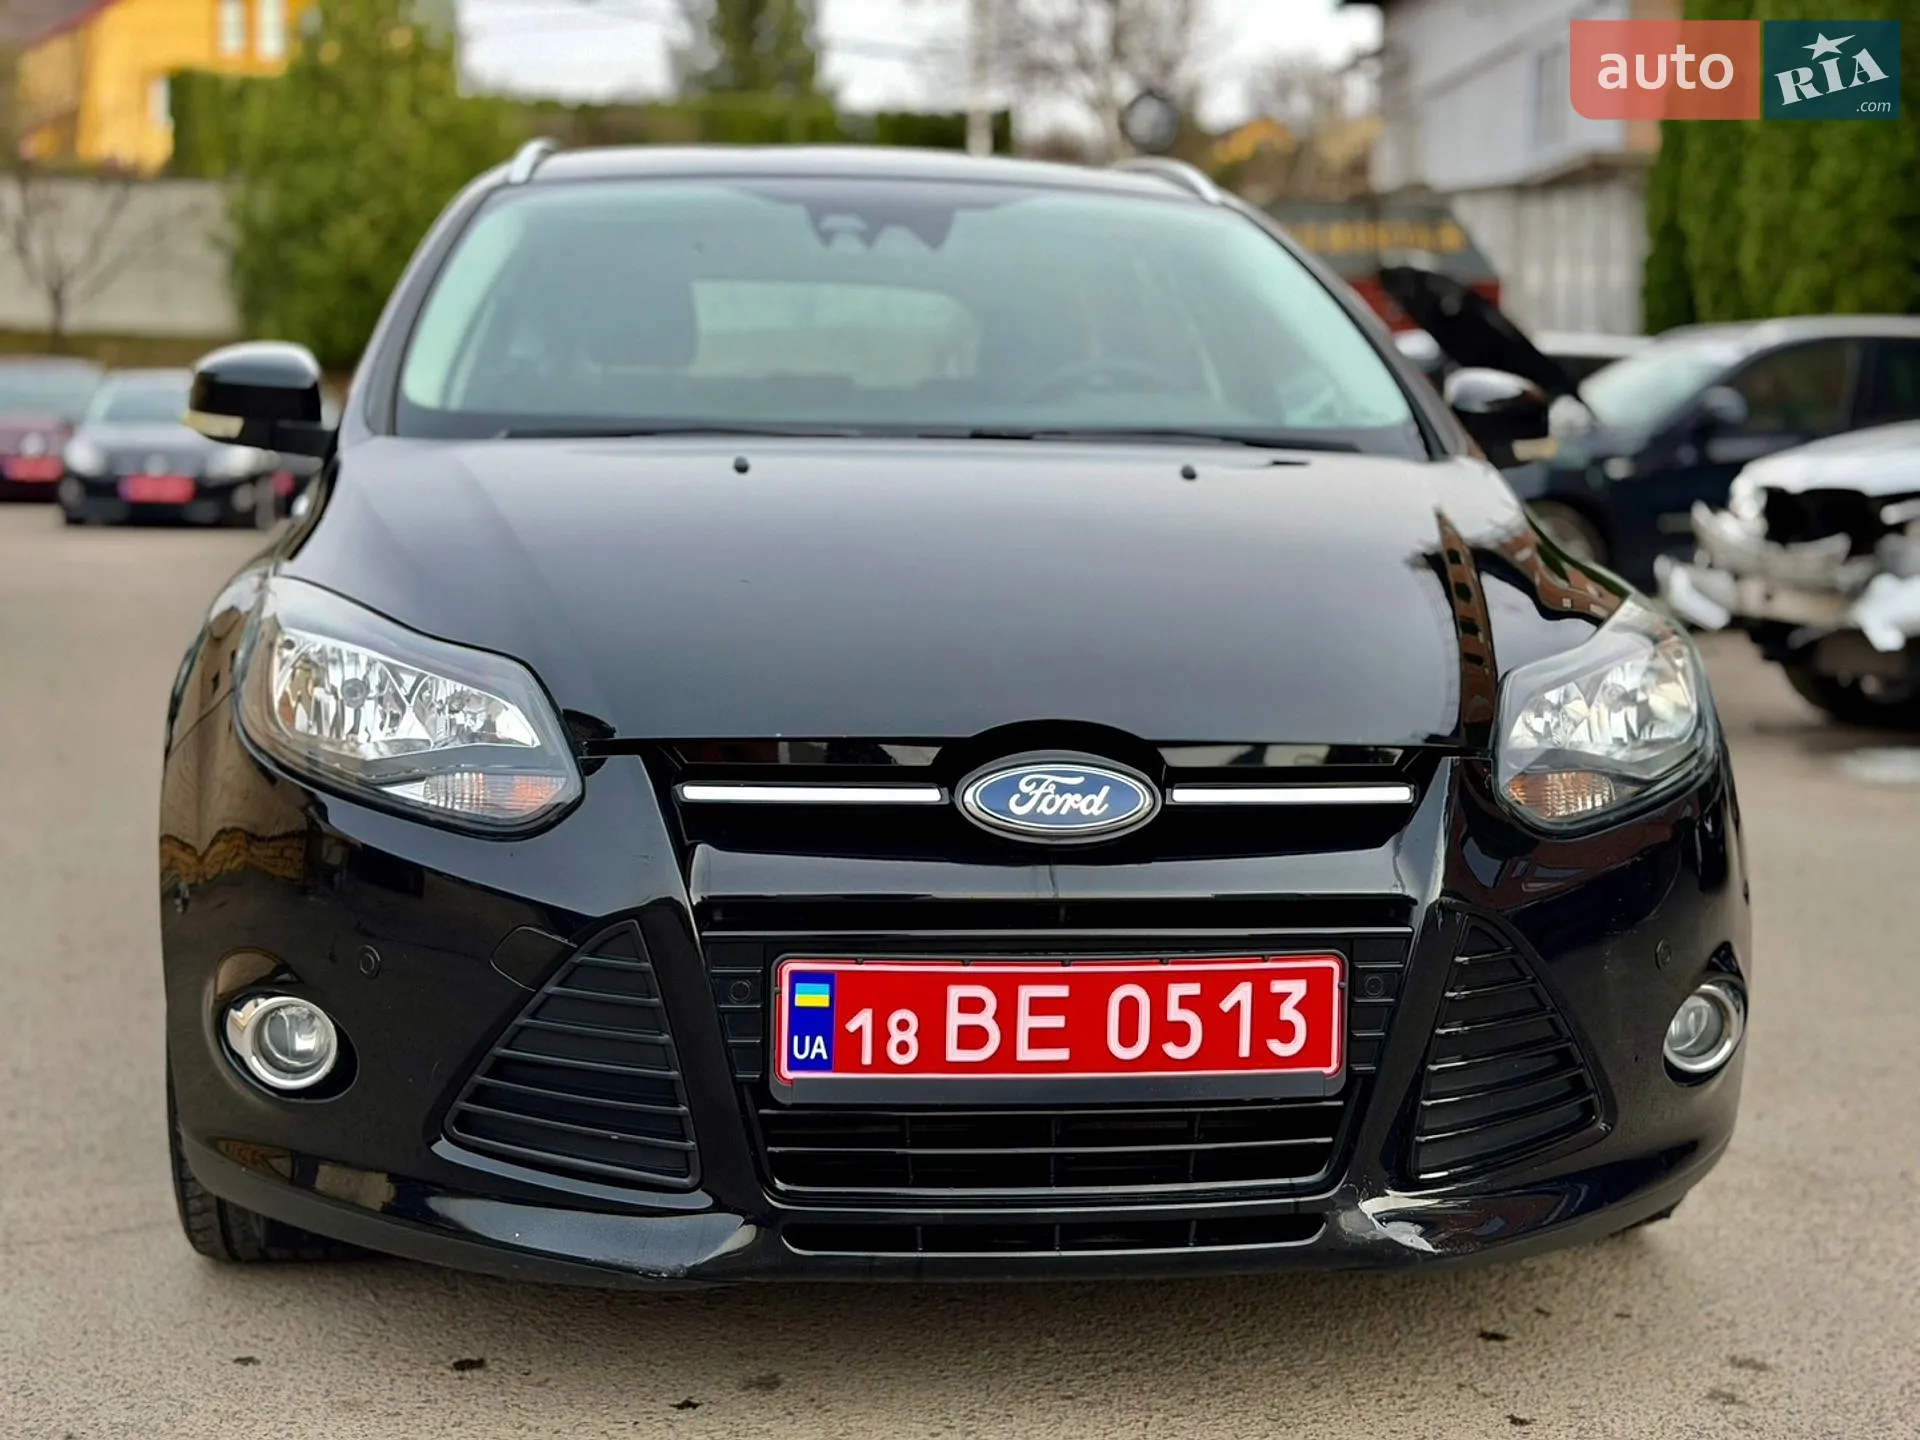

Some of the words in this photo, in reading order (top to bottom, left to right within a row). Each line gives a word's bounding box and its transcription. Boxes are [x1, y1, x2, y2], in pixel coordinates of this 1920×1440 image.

[1008, 774, 1111, 816] Ford
[844, 1008, 920, 1066] 18
[945, 984, 1070, 1063] BE
[1106, 979, 1308, 1061] 0513
[793, 1035, 828, 1061] UA
